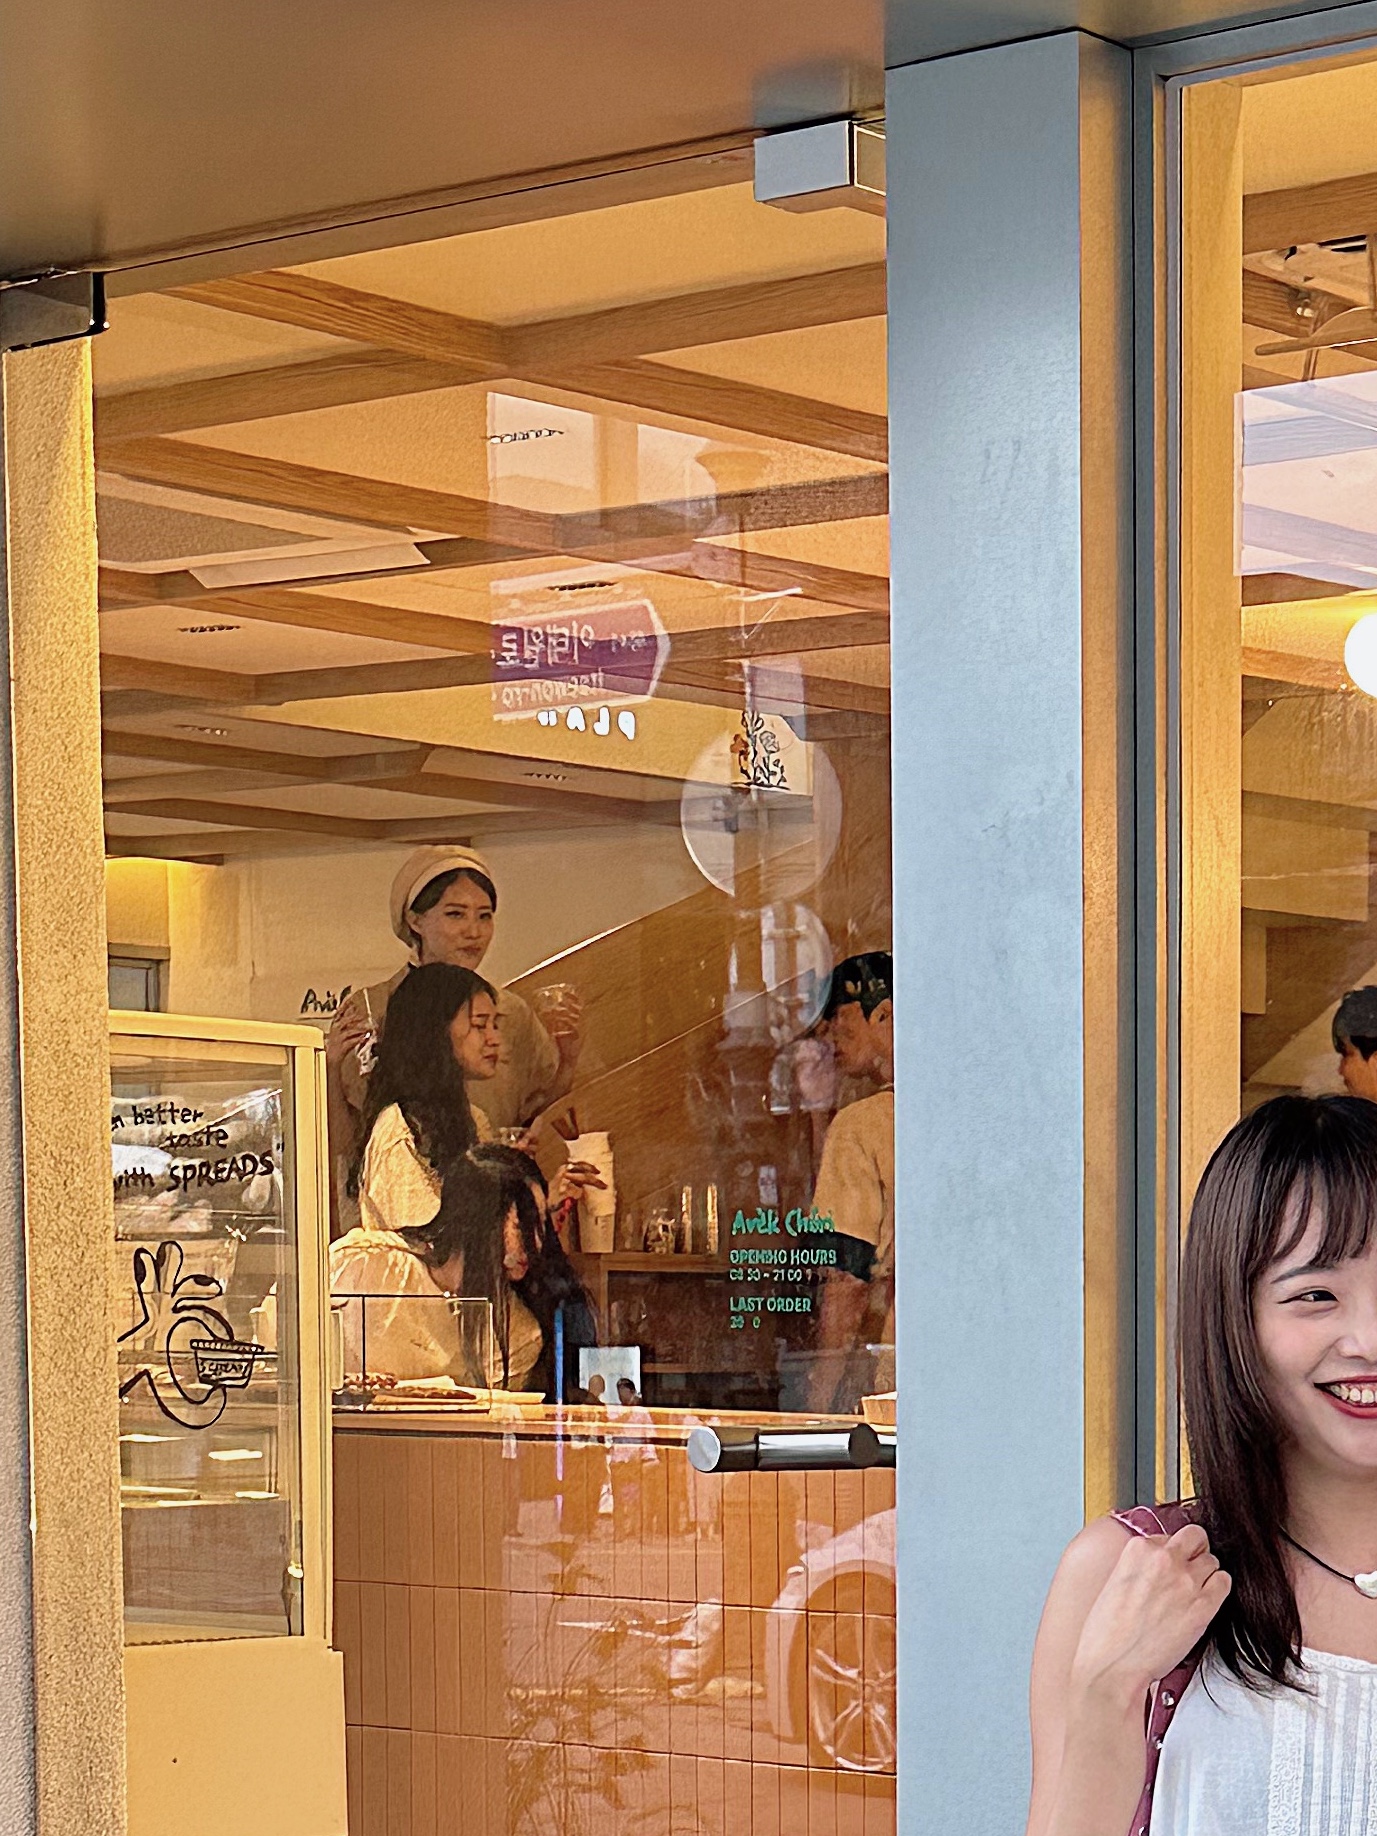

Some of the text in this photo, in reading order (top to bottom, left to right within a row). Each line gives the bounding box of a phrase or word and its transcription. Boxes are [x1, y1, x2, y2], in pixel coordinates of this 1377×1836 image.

[132, 1102, 204, 1125] better
[164, 1125, 229, 1149] taste
[790, 1249, 837, 1264] HOURS
[730, 1297, 812, 1313] LAST ORDER
